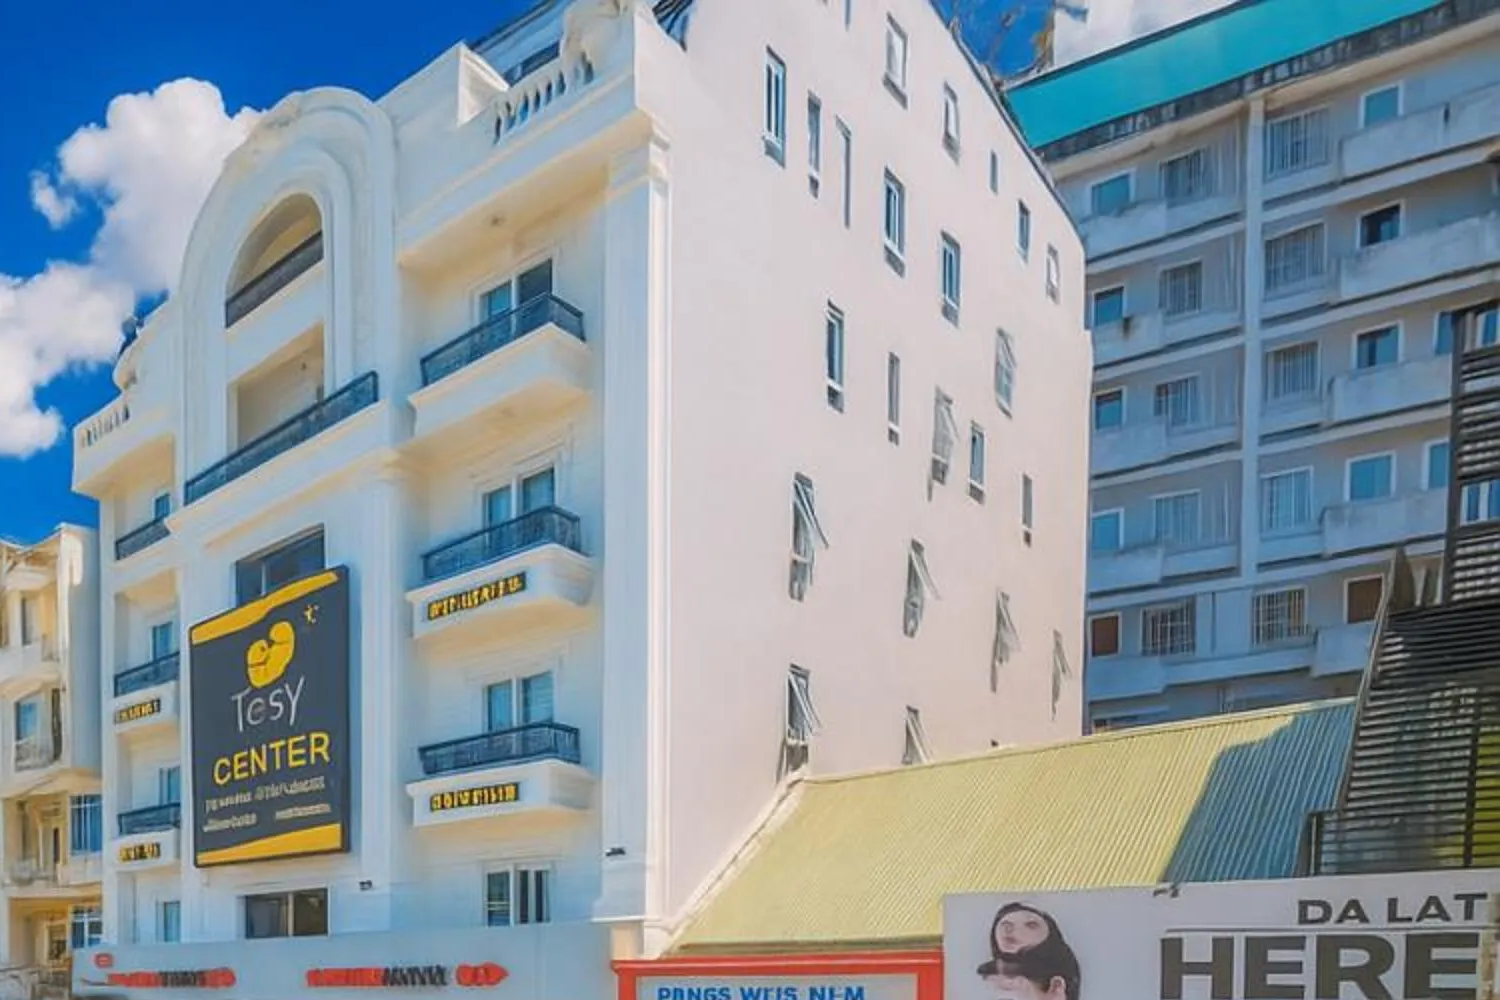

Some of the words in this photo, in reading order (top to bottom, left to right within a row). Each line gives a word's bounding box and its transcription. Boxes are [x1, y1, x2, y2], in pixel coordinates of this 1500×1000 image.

[212, 731, 331, 786] CENTER
[1297, 899, 1370, 925] DA
[1387, 892, 1488, 923] LAT
